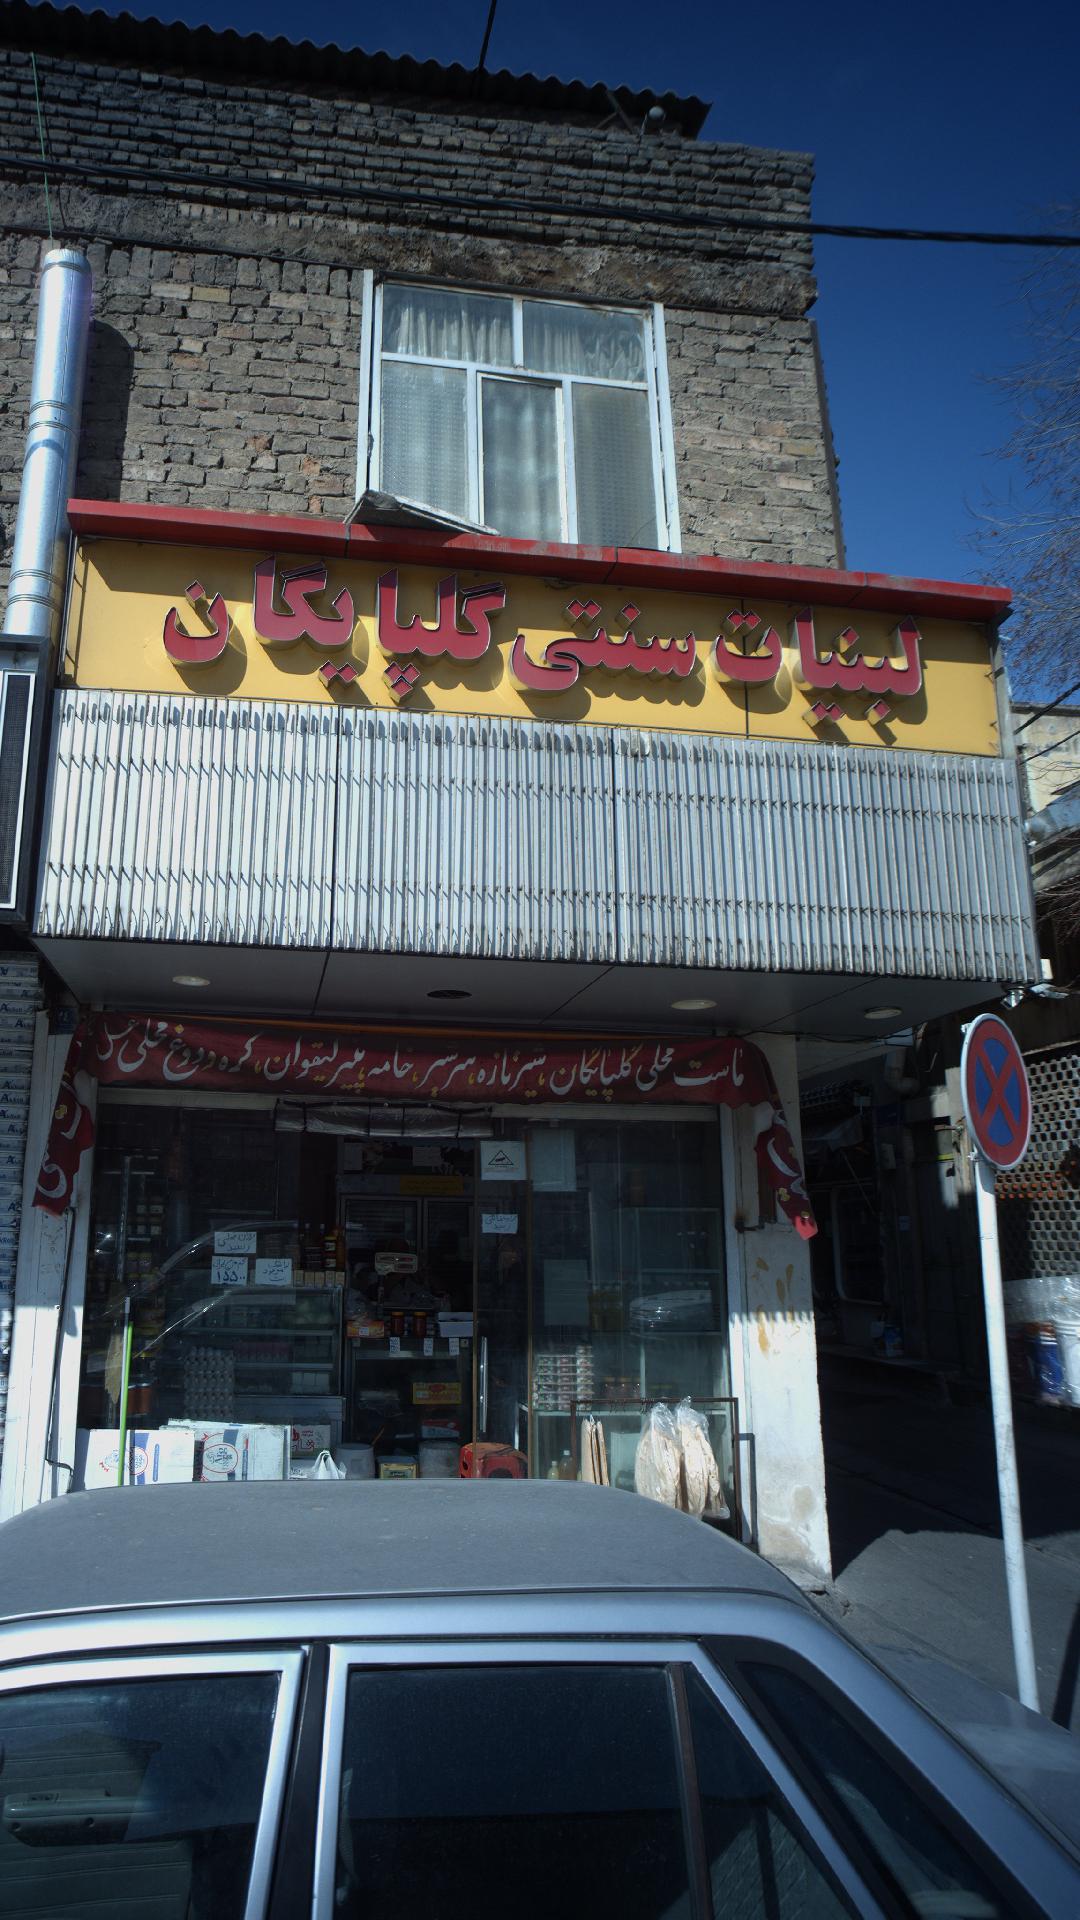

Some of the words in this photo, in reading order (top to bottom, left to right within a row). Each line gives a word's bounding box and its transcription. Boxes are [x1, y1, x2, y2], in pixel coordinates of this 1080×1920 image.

[163, 553, 508, 704] گلپایگان
[509, 597, 698, 694] سنتی
[712, 606, 924, 728] لبنیات
[117, 1017, 169, 1073] محلی
[635, 1043, 675, 1092] محلی
[673, 1047, 745, 1087] ماست
